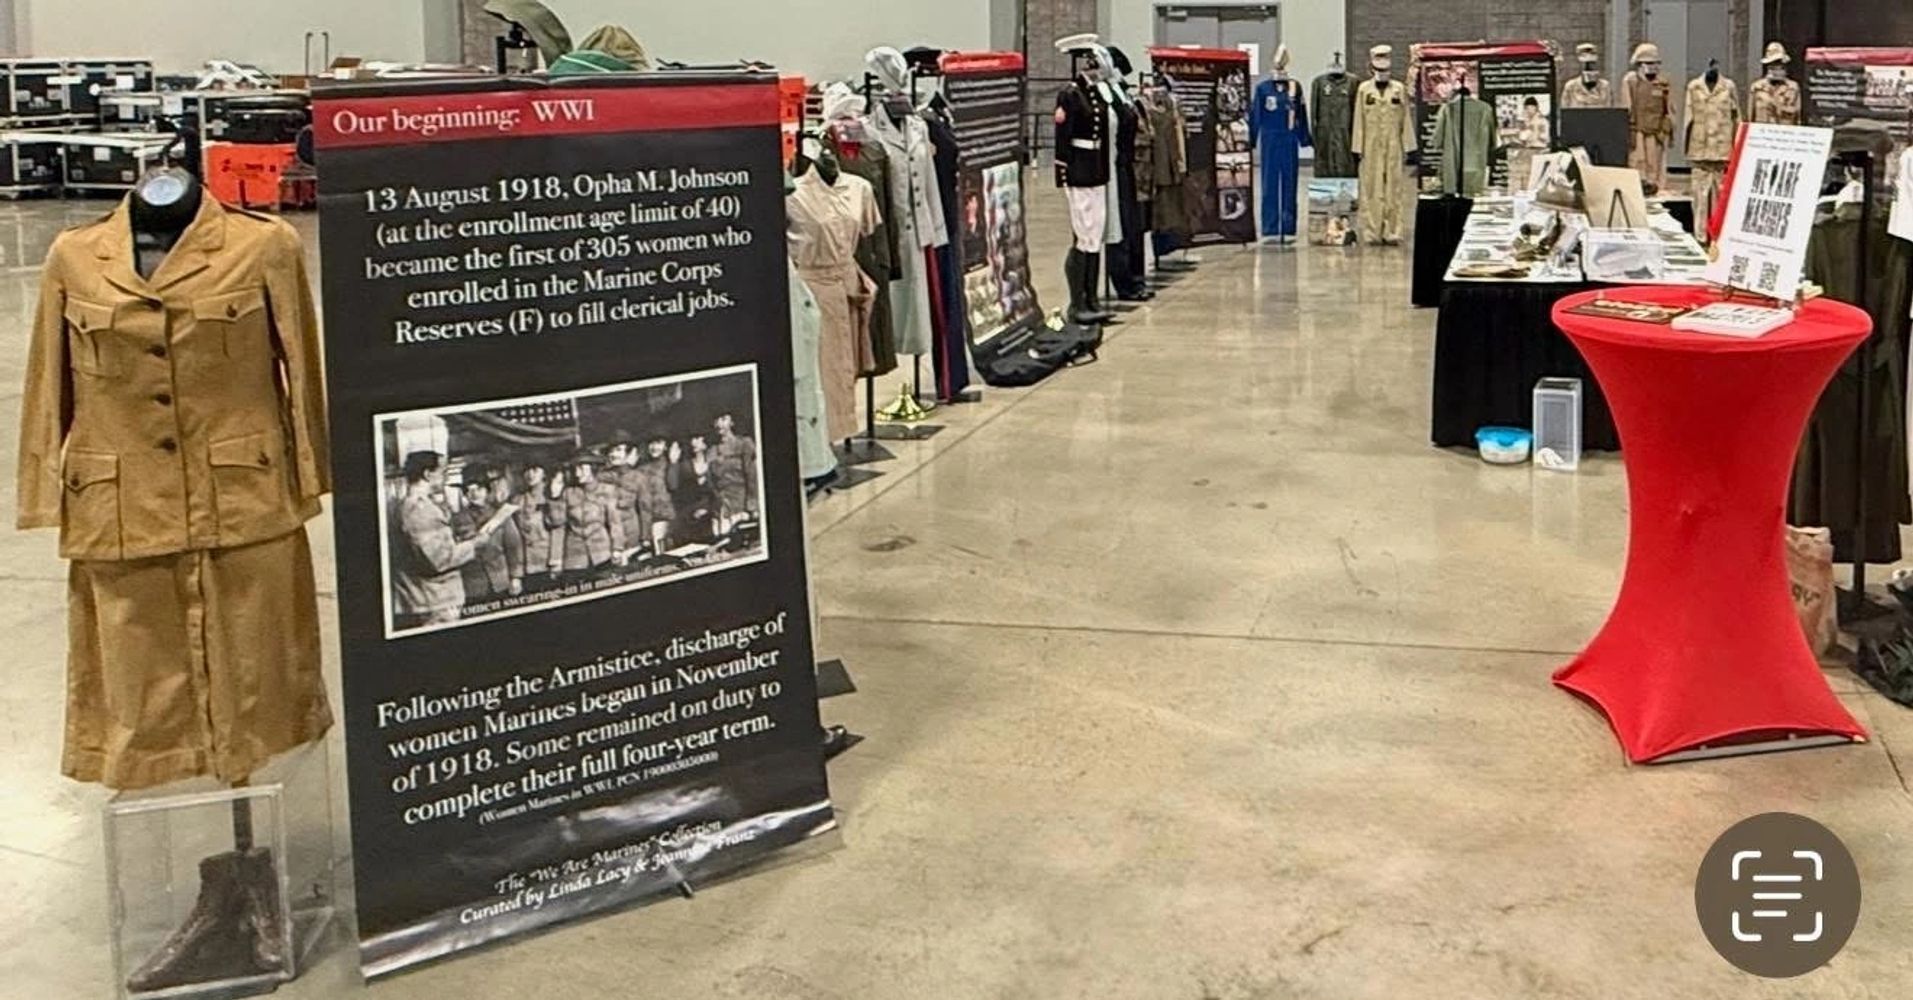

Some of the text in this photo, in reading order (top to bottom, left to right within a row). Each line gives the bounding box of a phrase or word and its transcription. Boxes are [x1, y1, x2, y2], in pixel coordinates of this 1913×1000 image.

[333, 98, 595, 137] Our beginning: WWI
[365, 167, 749, 214] 13 August 1918, Opha M. Johnson
[376, 193, 741, 248] (at the enrollment age limit of 40)
[365, 224, 752, 280] became the first of 305 women who
[407, 260, 723, 310] enrolled in the Marine Corps
[395, 286, 736, 345] Reserves (F) to fill clerical jobs.
[503, 583, 578, 609] swearing-in
[579, 579, 594, 593] in
[377, 610, 788, 728] Following the Armistice, discharge of
[388, 648, 780, 760] women Marines began in November
[391, 682, 782, 795] of 1918. Some remained on duty to
[403, 715, 777, 829] complete their full four-year term.
[478, 803, 527, 826] (Women
[527, 790, 570, 812] Marines
[569, 785, 583, 799] in
[495, 819, 723, 894] The "We Are Marines" Collection
[459, 888, 526, 925] Curated
[524, 886, 546, 911] by
[547, 871, 593, 901] Linda
[594, 861, 633, 889] Lacy
[633, 858, 648, 874] &
